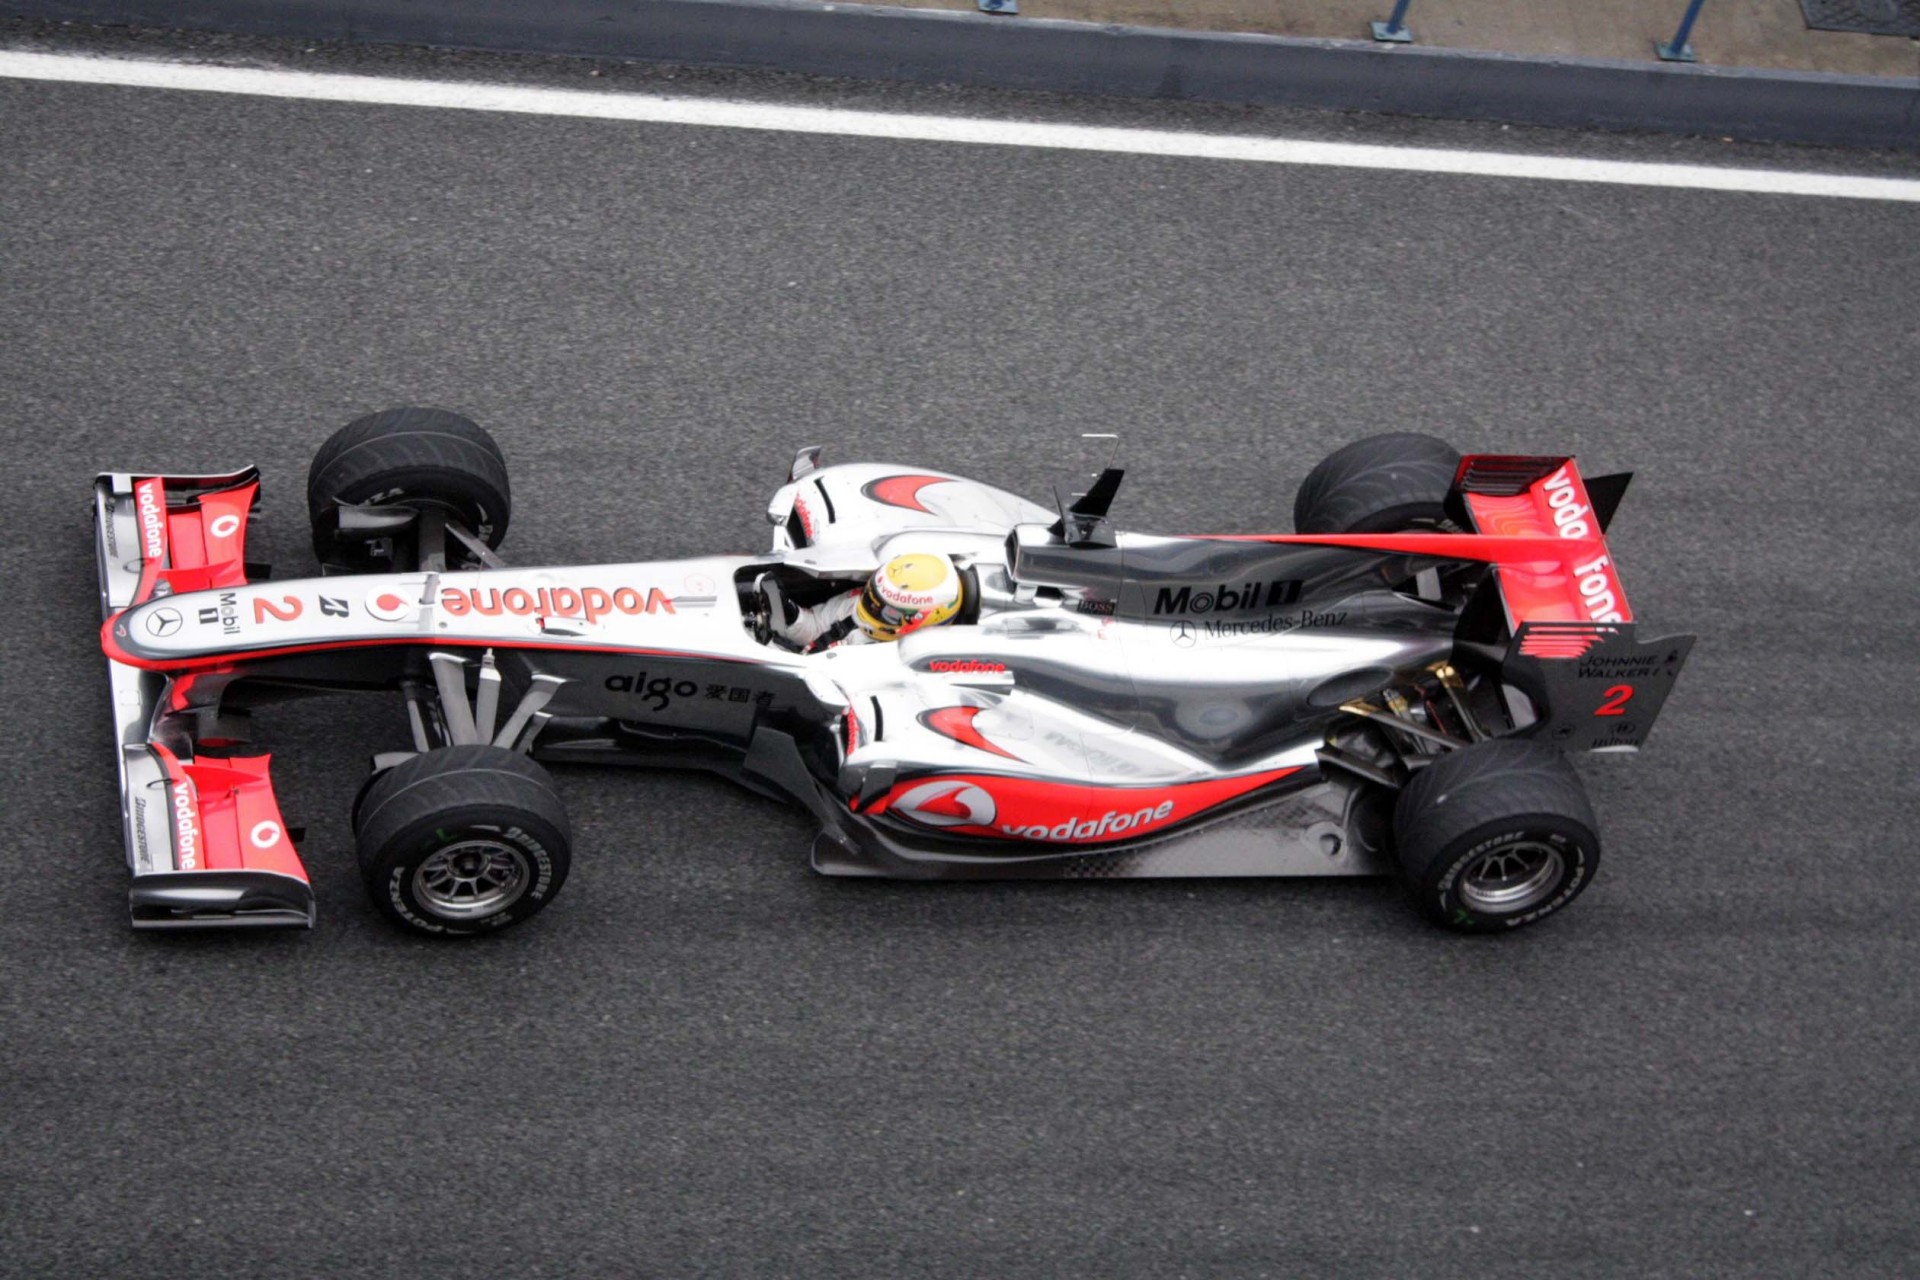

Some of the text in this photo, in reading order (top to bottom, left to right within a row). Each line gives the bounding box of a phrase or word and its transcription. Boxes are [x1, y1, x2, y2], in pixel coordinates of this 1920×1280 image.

[138, 483, 164, 559] vodafone
[253, 595, 303, 625] 2
[440, 587, 677, 624] vodafone
[882, 586, 934, 605] vodafone
[1153, 582, 1262, 615] Mobil
[219, 592, 241, 635] Mobil
[1204, 609, 1348, 640] Mercedes-Benz
[929, 659, 1006, 674] vodafone
[1578, 654, 1659, 667] JOHNNIE
[1578, 667, 1649, 679] WALKER
[604, 671, 698, 711] aigo
[1593, 684, 1635, 717] 2
[174, 782, 198, 870] vodafone
[1003, 800, 1175, 841] vodafone
[502, 826, 553, 900] BRIDGESTONE
